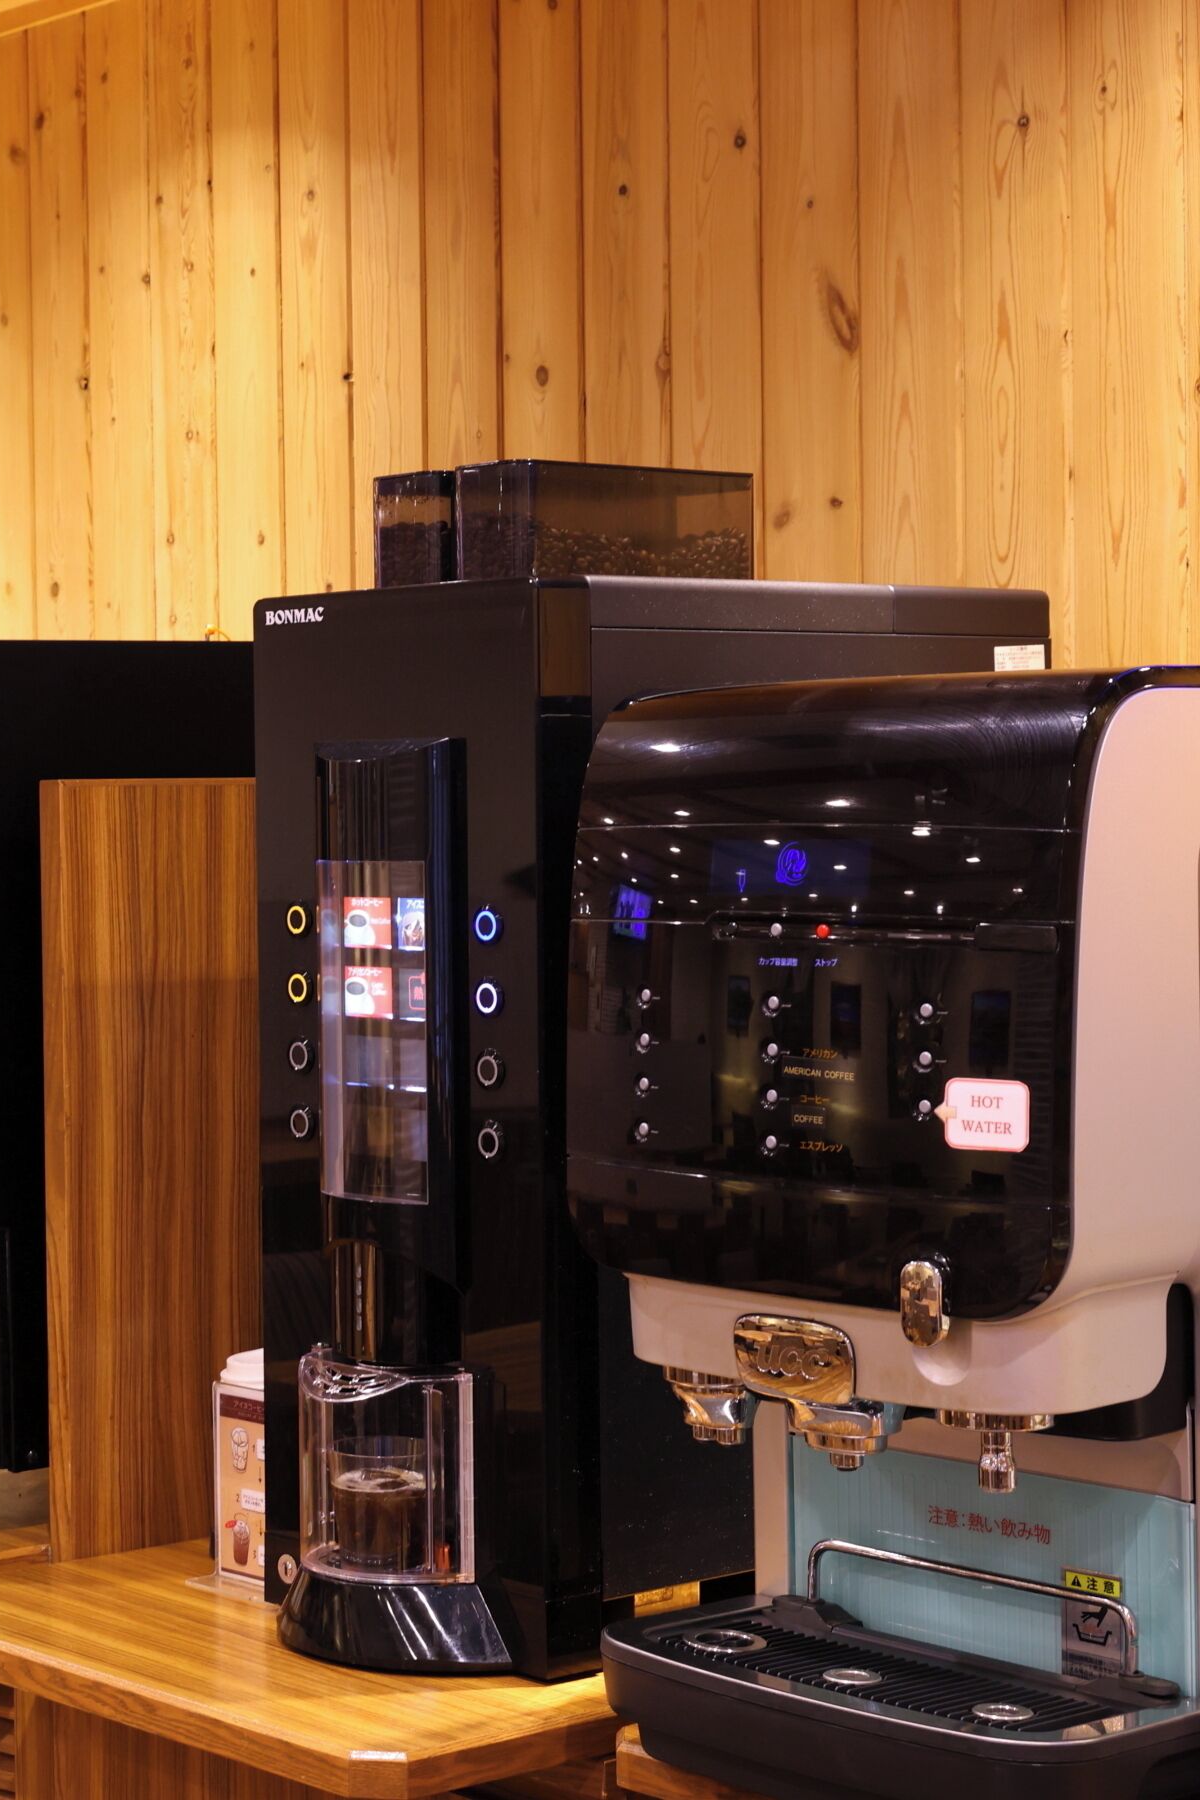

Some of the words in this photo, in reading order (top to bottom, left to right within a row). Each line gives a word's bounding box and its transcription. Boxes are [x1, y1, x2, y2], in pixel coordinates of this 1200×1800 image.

[265, 606, 325, 626] BONMAC
[815, 958, 838, 967] ストップ
[802, 1048, 839, 1059] アメリカン
[783, 1066, 821, 1077] AMERICAN
[824, 1070, 855, 1081] COFFEE
[800, 1095, 830, 1104] コーヒー
[970, 1095, 1004, 1109] HOT
[793, 1114, 824, 1124] COFFEE
[961, 1119, 1012, 1135] WATER
[800, 1141, 843, 1153] エスプレッソ
[1086, 1576, 1115, 1594] 注意
